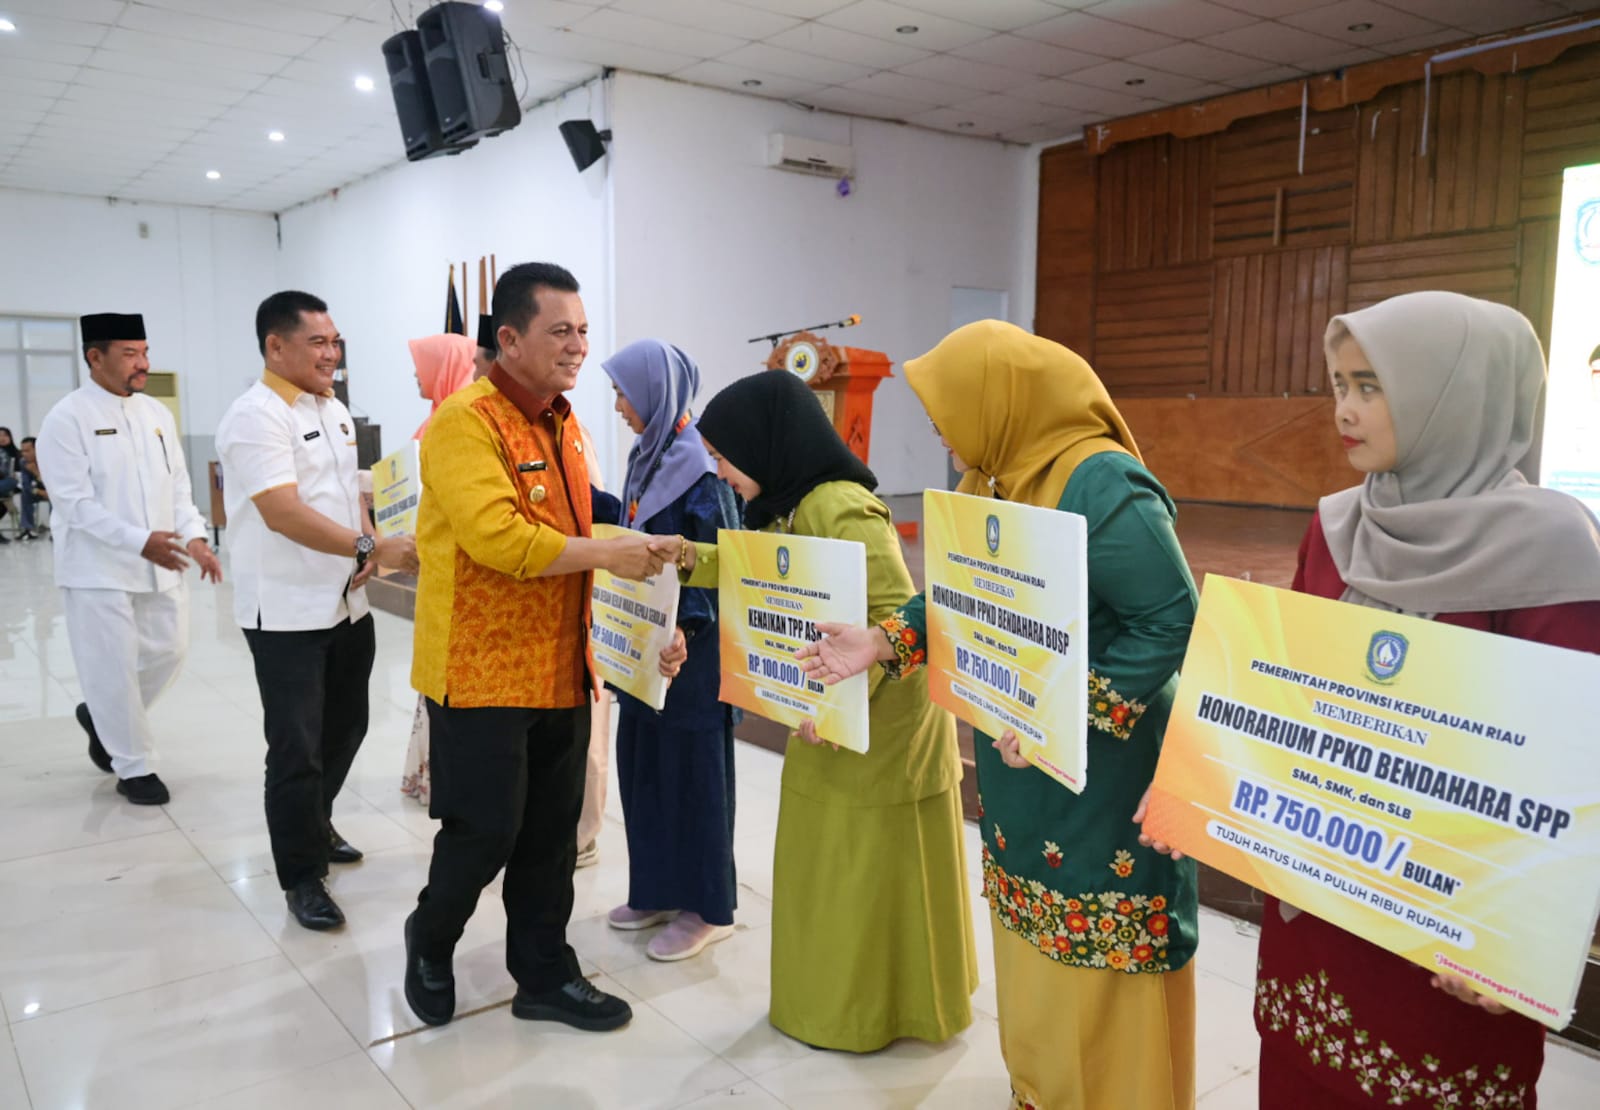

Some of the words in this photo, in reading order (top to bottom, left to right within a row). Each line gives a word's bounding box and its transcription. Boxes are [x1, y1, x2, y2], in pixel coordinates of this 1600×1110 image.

[948, 552, 977, 566] PEMERINTAH
[977, 561, 1000, 574] PROVINSI
[1000, 567, 1031, 585] KEPULAUAN
[1031, 577, 1045, 589] RIAU
[748, 608, 787, 635] KENAIKAN
[787, 617, 804, 639] TPP
[932, 584, 976, 618] HONORARIUM
[977, 599, 997, 625] PPKD
[998, 607, 1045, 646] BENDAHARA
[1046, 625, 1070, 656] BOSP
[748, 653, 760, 674] RP.
[762, 657, 799, 686] 100.000
[800, 671, 806, 689] /
[956, 646, 970, 674] RP.
[970, 653, 1011, 694] 750.000
[1012, 673, 1018, 698] /
[1251, 660, 1328, 691] PEMERINTAH
[1328, 681, 1393, 710] PROVINSI
[1394, 700, 1484, 735] KEPULAUAN
[1485, 725, 1526, 746] RIAU
[1313, 700, 1428, 746] MEMBERIKAN
[1198, 694, 1318, 755] HONORARIUM
[1317, 732, 1373, 774] PPKD
[1374, 752, 1512, 823] BENDAHARA
[1516, 798, 1571, 839] SPP
[1292, 768, 1322, 789] SMA,
[1324, 780, 1356, 802] SMK,
[1359, 793, 1385, 810] dan
[1387, 803, 1412, 820] SLB
[1234, 780, 1269, 819] RP.
[1272, 794, 1383, 863] 750.000
[1384, 841, 1406, 871] /
[1216, 825, 1252, 849] TUJUH
[1252, 842, 1290, 866] RATUS
[1291, 859, 1321, 880] LIMA
[1323, 873, 1368, 900] PULUH
[1370, 894, 1404, 915] RIBU
[1406, 909, 1462, 942] RUPIAH
[1475, 973, 1517, 998] Kategori
[1518, 993, 1560, 1017] Sekolah
